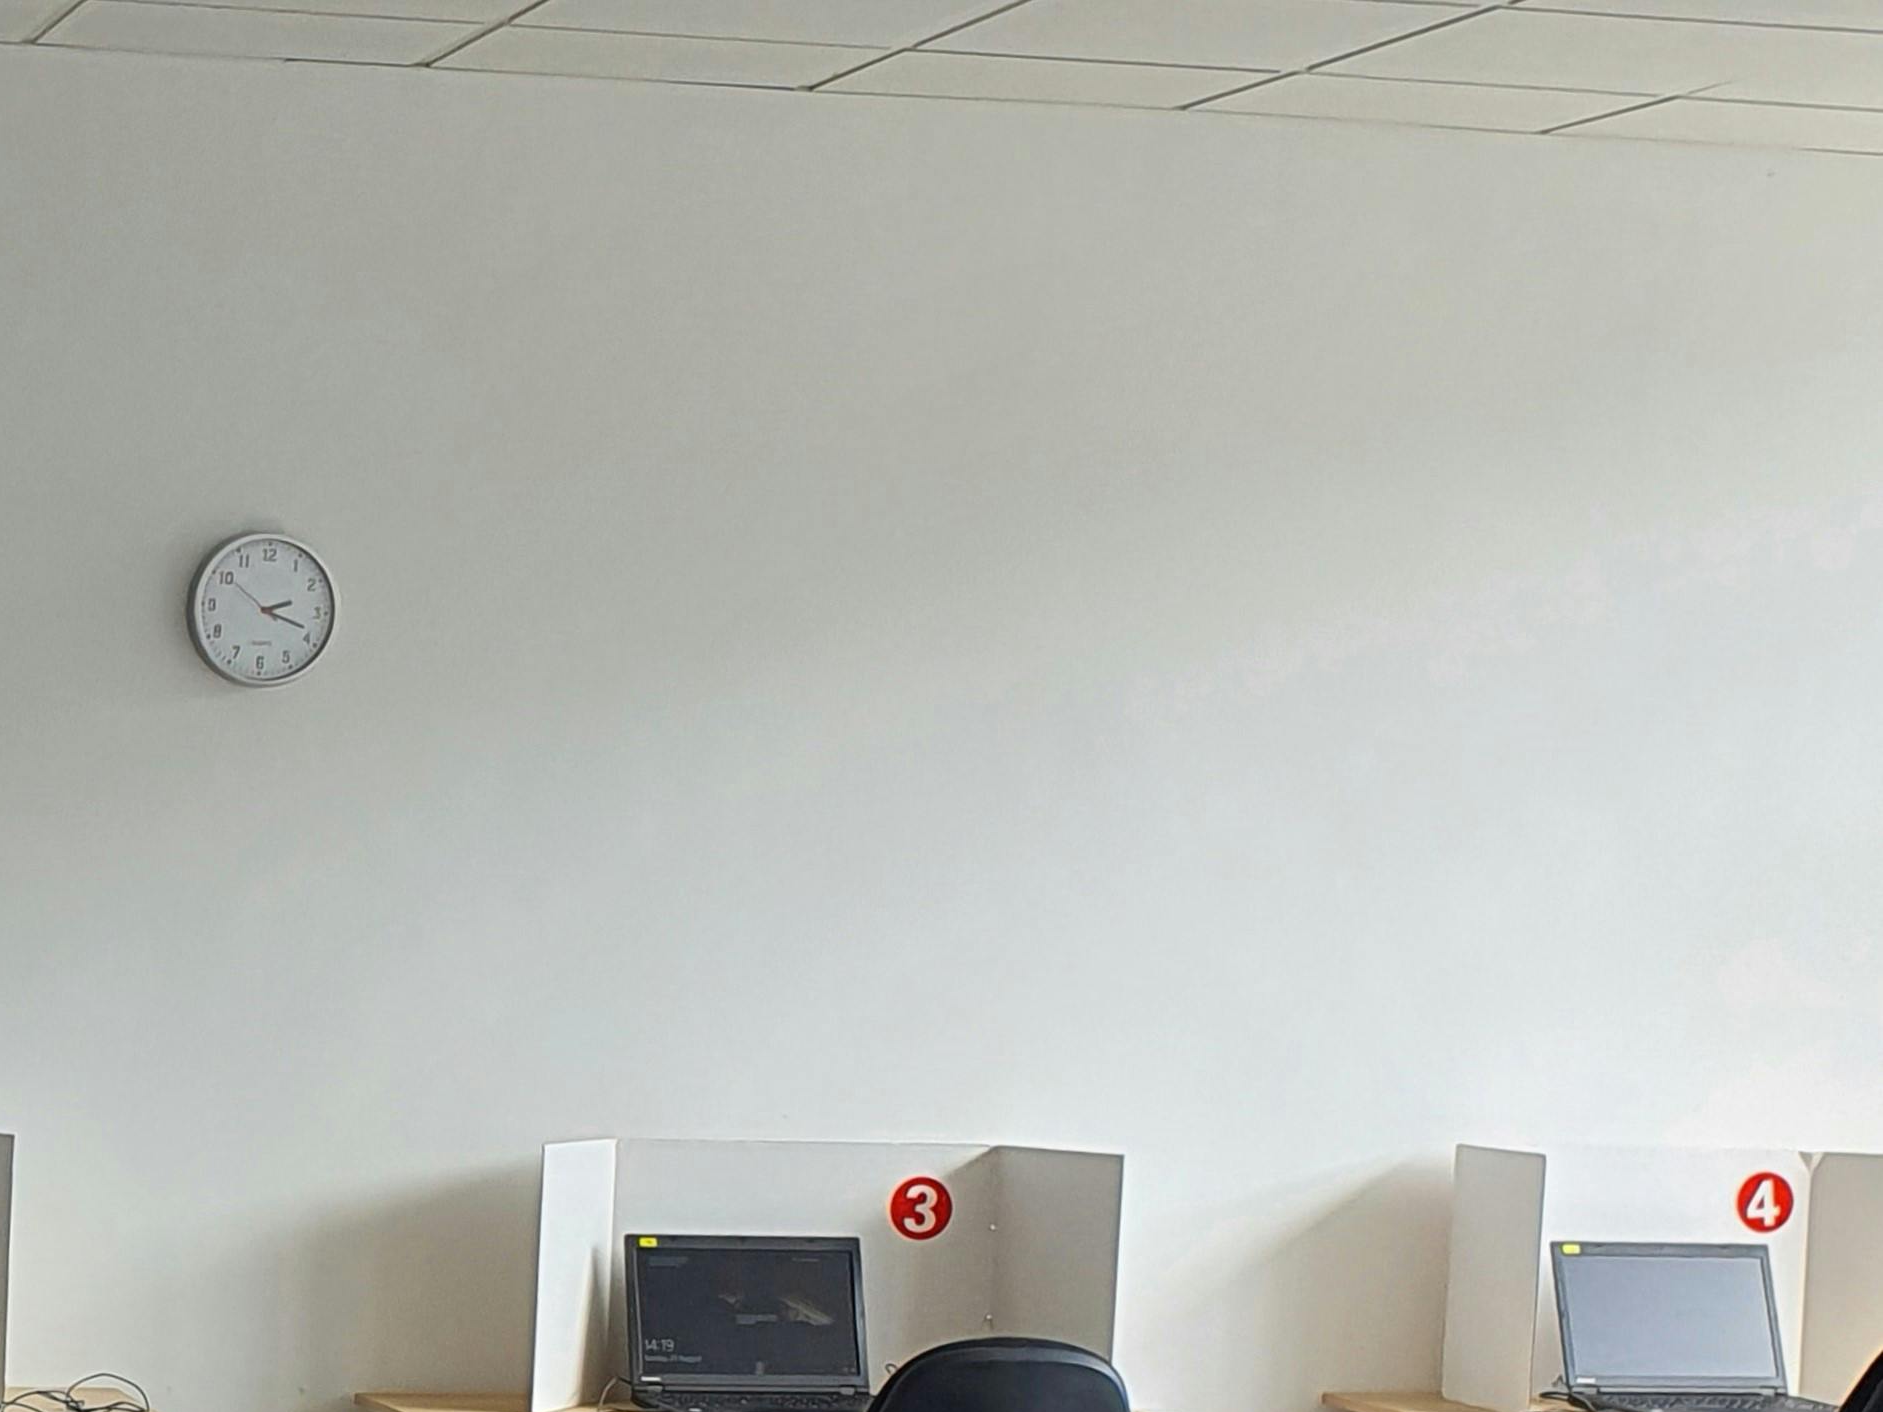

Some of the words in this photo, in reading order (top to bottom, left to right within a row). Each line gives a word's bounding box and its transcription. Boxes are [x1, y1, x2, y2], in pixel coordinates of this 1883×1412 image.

[238, 554, 250, 568] 11
[262, 548, 277, 562] 12
[292, 560, 298, 572] 1
[219, 571, 234, 585] 10
[307, 578, 316, 591] 2
[208, 598, 216, 611] 9
[312, 606, 321, 619] 3
[214, 624, 222, 638] 8
[302, 632, 310, 645] 4
[232, 646, 240, 658] 7
[282, 650, 290, 664] 5
[256, 656, 264, 670] 6
[903, 1184, 938, 1233] 3
[1747, 1179, 1780, 1227] 4
[645, 1338, 675, 1352] 14:19
